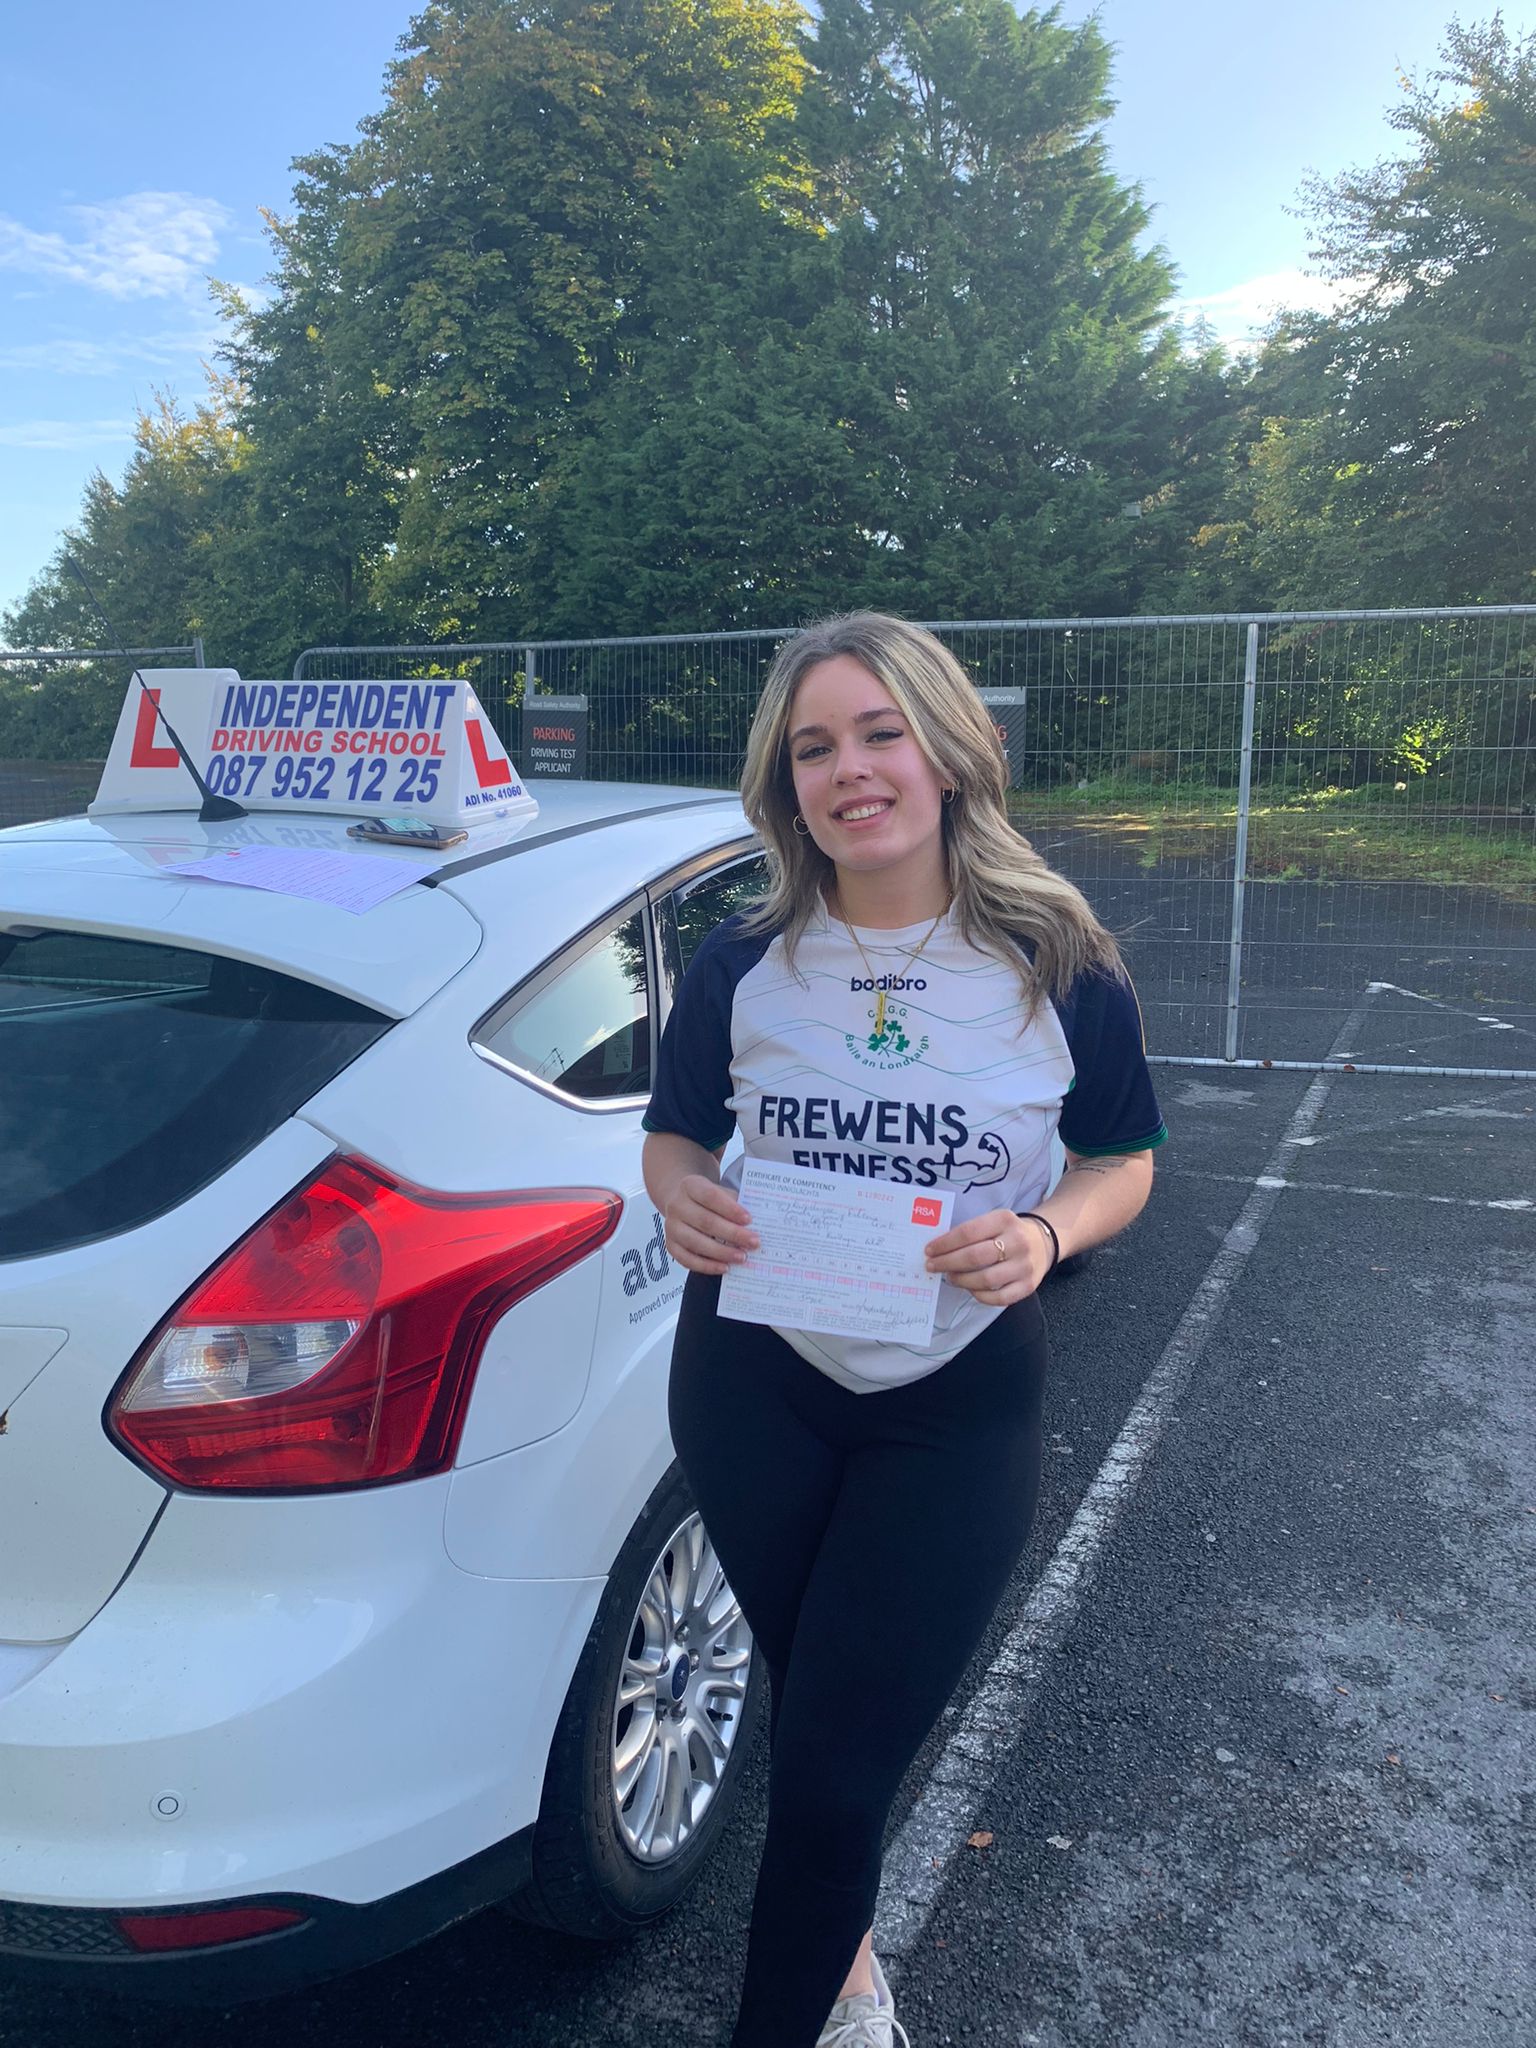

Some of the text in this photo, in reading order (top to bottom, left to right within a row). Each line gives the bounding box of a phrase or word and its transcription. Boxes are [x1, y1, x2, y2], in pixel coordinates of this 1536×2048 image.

[220, 685, 456, 729] INDEPENDENT
[983, 694, 1016, 703] Authority
[130, 688, 181, 768] L
[532, 727, 576, 742] PARKING
[211, 729, 446, 756] DRIVING SCHOOL
[464, 719, 512, 788] L
[530, 747, 577, 760] DRIVING TEST
[205, 754, 441, 803] 087 952 12 25
[534, 761, 572, 774] APPLICANT
[465, 785, 522, 807] ADI No. 41060
[850, 973, 927, 992] bodibro
[845, 1034, 861, 1060] Baile
[861, 1059, 876, 1068] an
[759, 1095, 969, 1149] FREWENS
[746, 1170, 836, 1192] CERTIFICATE OF COMPETENCY
[914, 1205, 935, 1217] RSA
[620, 1212, 670, 1297] ad
[629, 1296, 661, 1324] Approved
